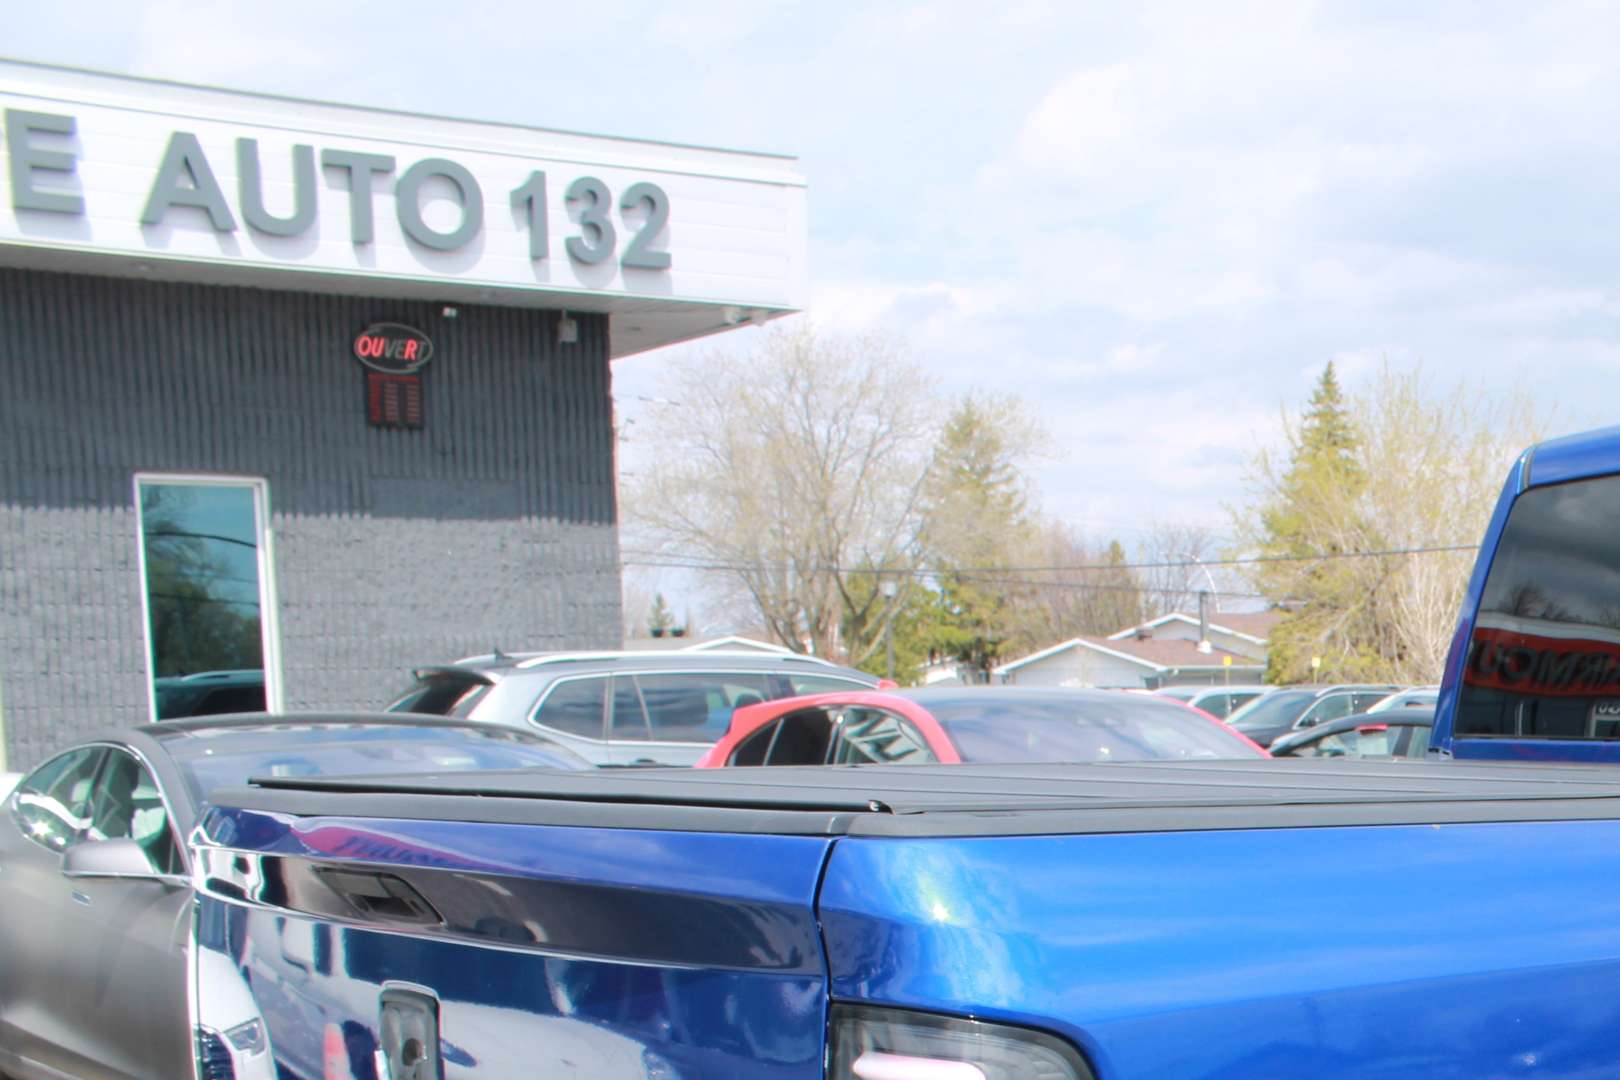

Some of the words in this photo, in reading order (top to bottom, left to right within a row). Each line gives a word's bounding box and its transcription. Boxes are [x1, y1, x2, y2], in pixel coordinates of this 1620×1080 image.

[139, 130, 485, 251] AUTO
[509, 169, 673, 271] 132
[358, 335, 426, 361] OUVERT
